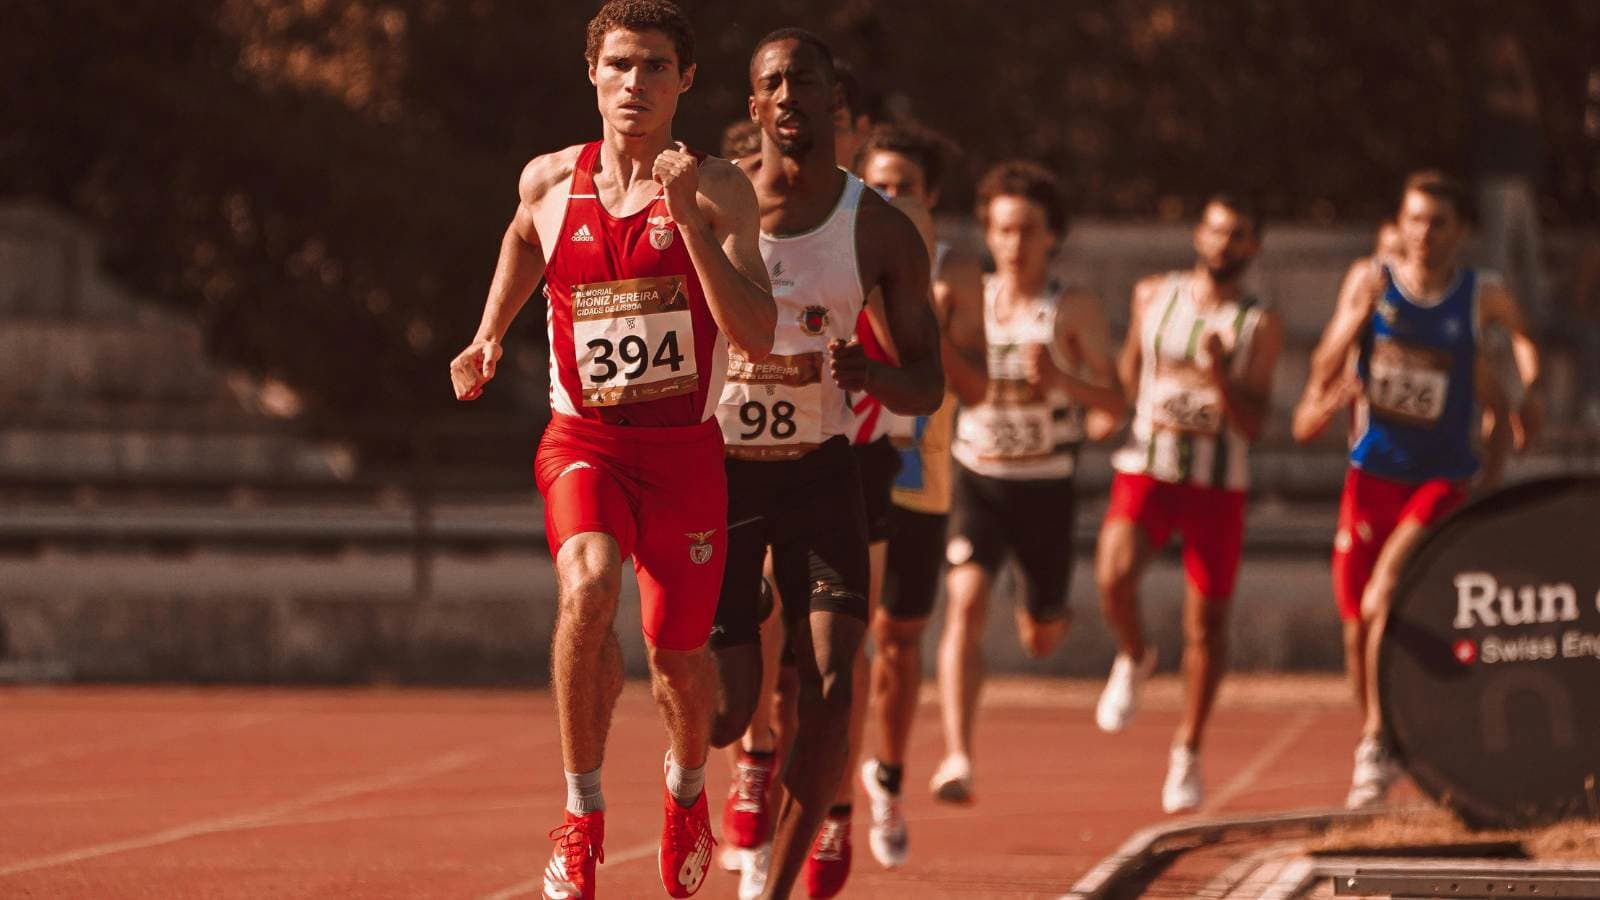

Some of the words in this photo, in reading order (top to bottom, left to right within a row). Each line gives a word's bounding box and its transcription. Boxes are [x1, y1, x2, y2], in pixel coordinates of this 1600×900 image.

[571, 234, 594, 242] adidas
[576, 288, 613, 298] MEMORIAL
[576, 296, 611, 308] MONIZ
[613, 291, 658, 303] PEREIRA
[576, 307, 604, 317] CIDADE
[604, 305, 615, 313] DE
[615, 303, 641, 312] LISBOA
[586, 330, 684, 384] 394
[729, 360, 754, 372] ONIZ
[755, 364, 799, 376] PEREIRA
[1379, 377, 1437, 417] 126
[739, 400, 797, 441] 98
[1453, 572, 1579, 629] Run
[1481, 635, 1557, 664] Swiss
